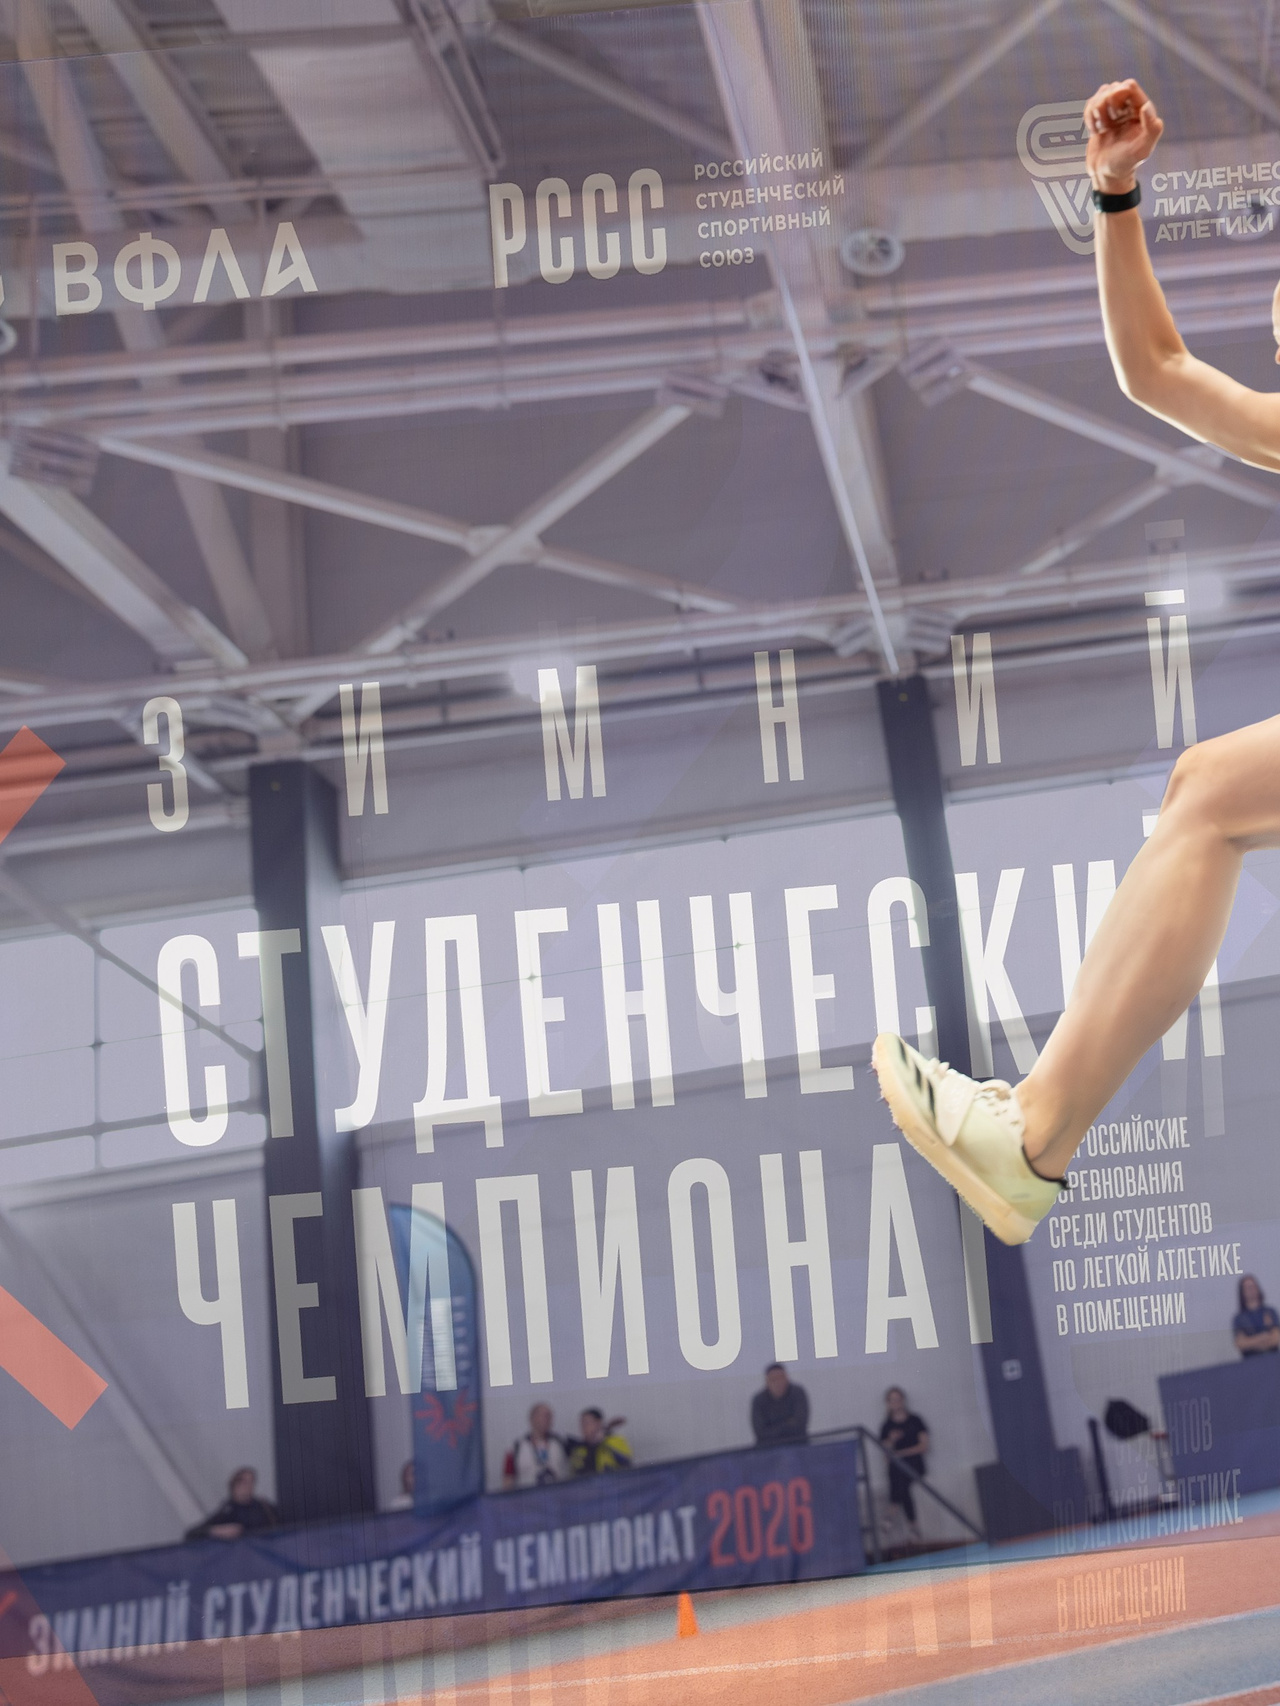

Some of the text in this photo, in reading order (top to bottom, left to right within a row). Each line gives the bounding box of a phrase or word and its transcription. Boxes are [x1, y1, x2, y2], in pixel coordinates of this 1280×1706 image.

[694, 148, 824, 180] РОССИЙСКИЙ
[695, 174, 845, 209] СТУДЕНЧЕСКИЙ
[1153, 194, 1212, 218] ЛИГА
[489, 168, 667, 289] РССС
[698, 205, 831, 239] СПОРТИВНЫЙ
[1154, 212, 1274, 243] АТЛЕТИКИ
[52, 221, 319, 316] ВФЛА
[700, 247, 755, 268] СОЮЗ
[157, 814, 1225, 1154] СТУДЕНЧЕСК
[1072, 1114, 1190, 1158] ОССИЙСКИЕ
[1054, 1161, 1184, 1204] РЕВНОВАНИЯ
[1049, 1202, 1213, 1249] СРЕДИ СТУДЕНТОВ
[1053, 1243, 1244, 1292] ПО ЛЕГКОЙ АТЛЕТИКЕ
[1056, 1292, 1187, 1336] В ПОМЕЩЕНИИ
[27, 1580, 191, 1677] ЗИМНИЙ
[203, 1531, 484, 1647] СТУДЕНЧЕСКИЙ
[494, 1504, 697, 1593] ЧЕМПИОНАТ
[706, 1476, 816, 1568] 2026
